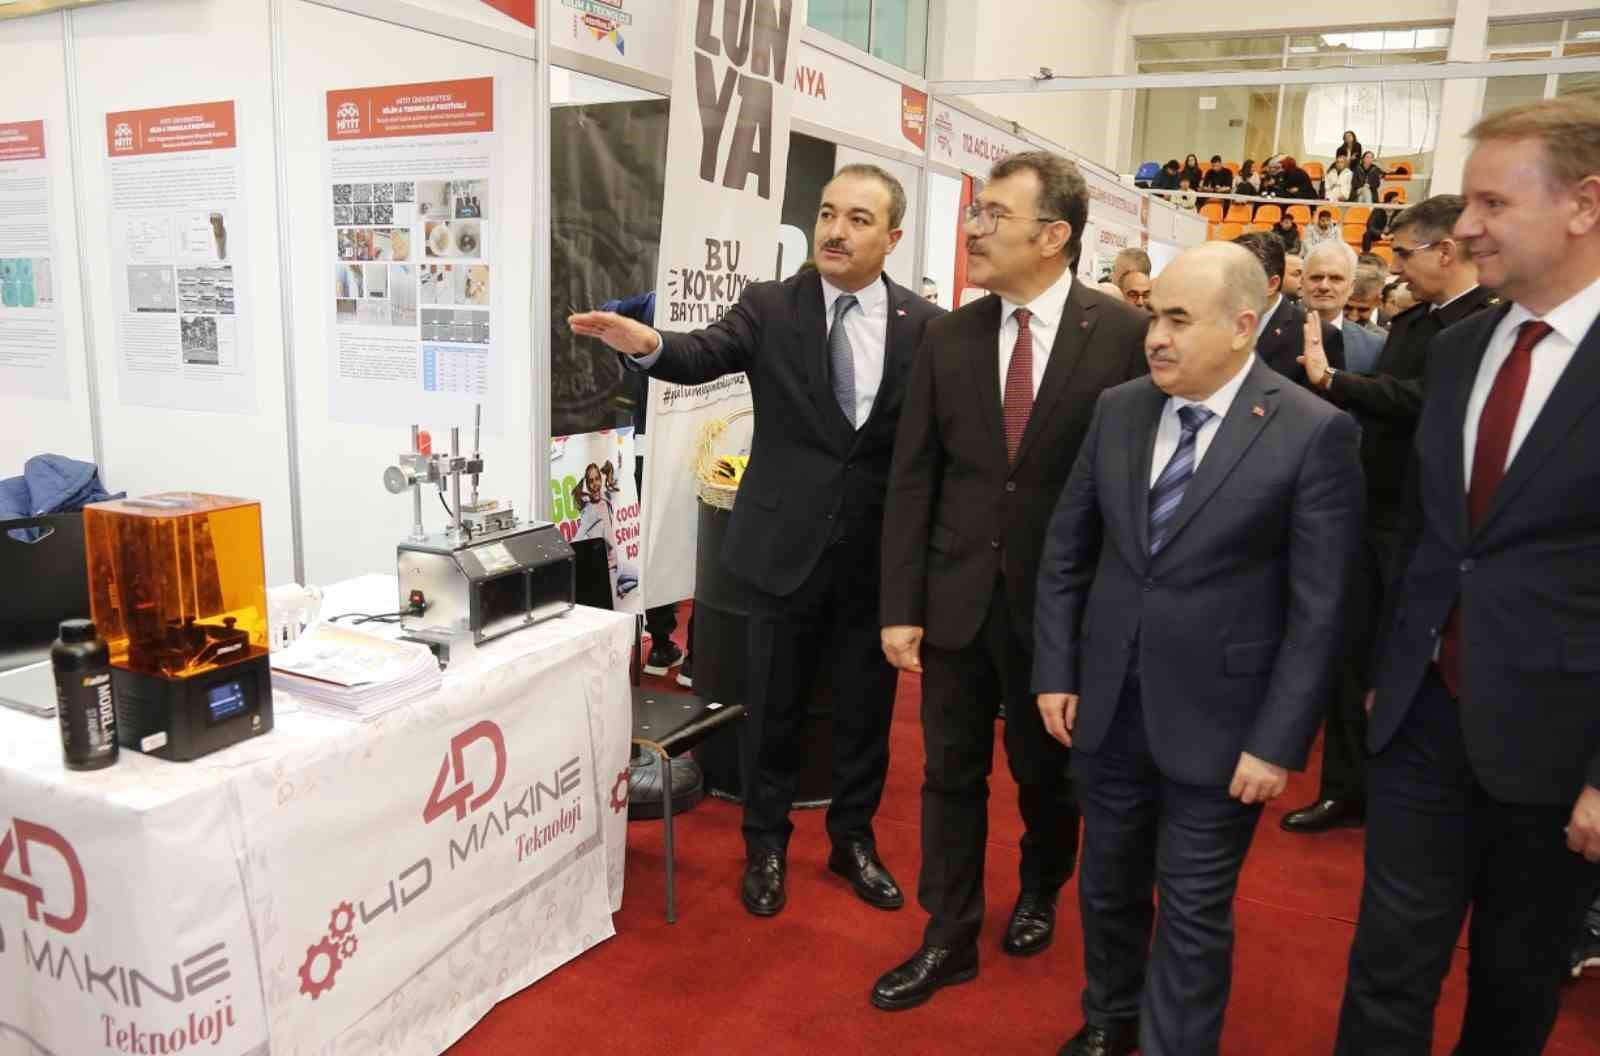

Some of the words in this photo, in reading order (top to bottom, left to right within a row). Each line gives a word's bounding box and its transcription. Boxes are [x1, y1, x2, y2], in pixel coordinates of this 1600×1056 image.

[694, 52, 773, 200] YA
[681, 268, 758, 302] KOKUY
[705, 238, 741, 272] BU
[422, 719, 507, 825] 4D
[448, 755, 581, 870] MAKINE
[514, 795, 582, 862] Teknoloji
[22, 929, 231, 1008] MAKINE
[101, 994, 235, 1056] Teknoloji
